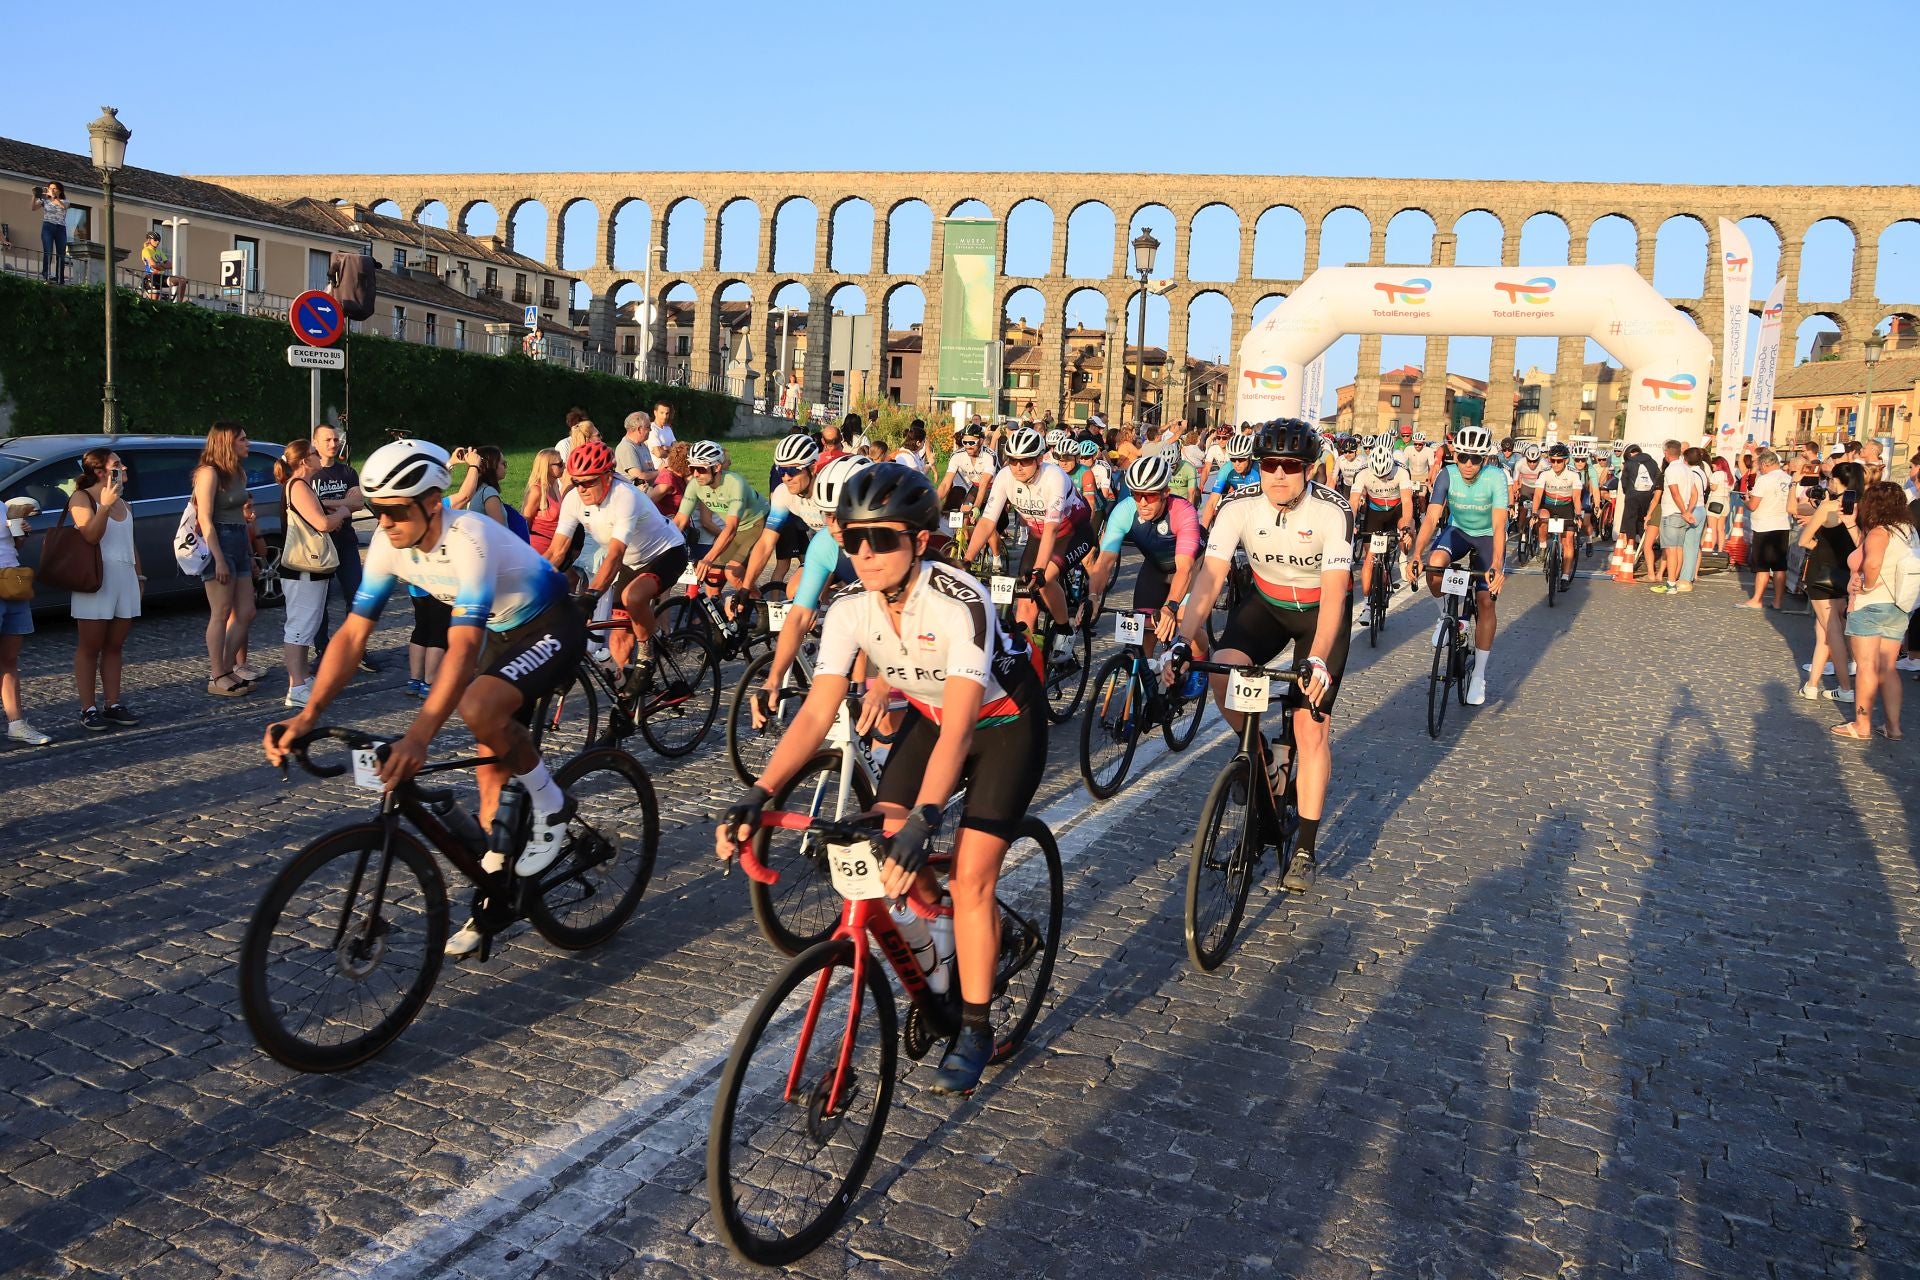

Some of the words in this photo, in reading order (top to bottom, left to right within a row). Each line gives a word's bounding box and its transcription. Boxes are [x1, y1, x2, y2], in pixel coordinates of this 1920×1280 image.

[221, 261, 235, 286] P
[1372, 309, 1430, 319] TotalEnergies
[1492, 310, 1554, 319] TotalEnergies
[293, 349, 329, 359] EXCEPTO
[330, 352, 341, 360] BUS
[1638, 404, 1693, 416] TotalEnergies
[312, 479, 348, 496] Nebraska
[1016, 498, 1045, 509] HARO
[1066, 542, 1089, 563] HARO
[1327, 557, 1351, 565] LPRC
[1446, 576, 1464, 586] 466
[993, 584, 1012, 593] 1162
[1120, 621, 1139, 631] 483
[500, 633, 562, 681] PHILIPS
[914, 667, 947, 682] RIC
[1234, 684, 1262, 698] 107
